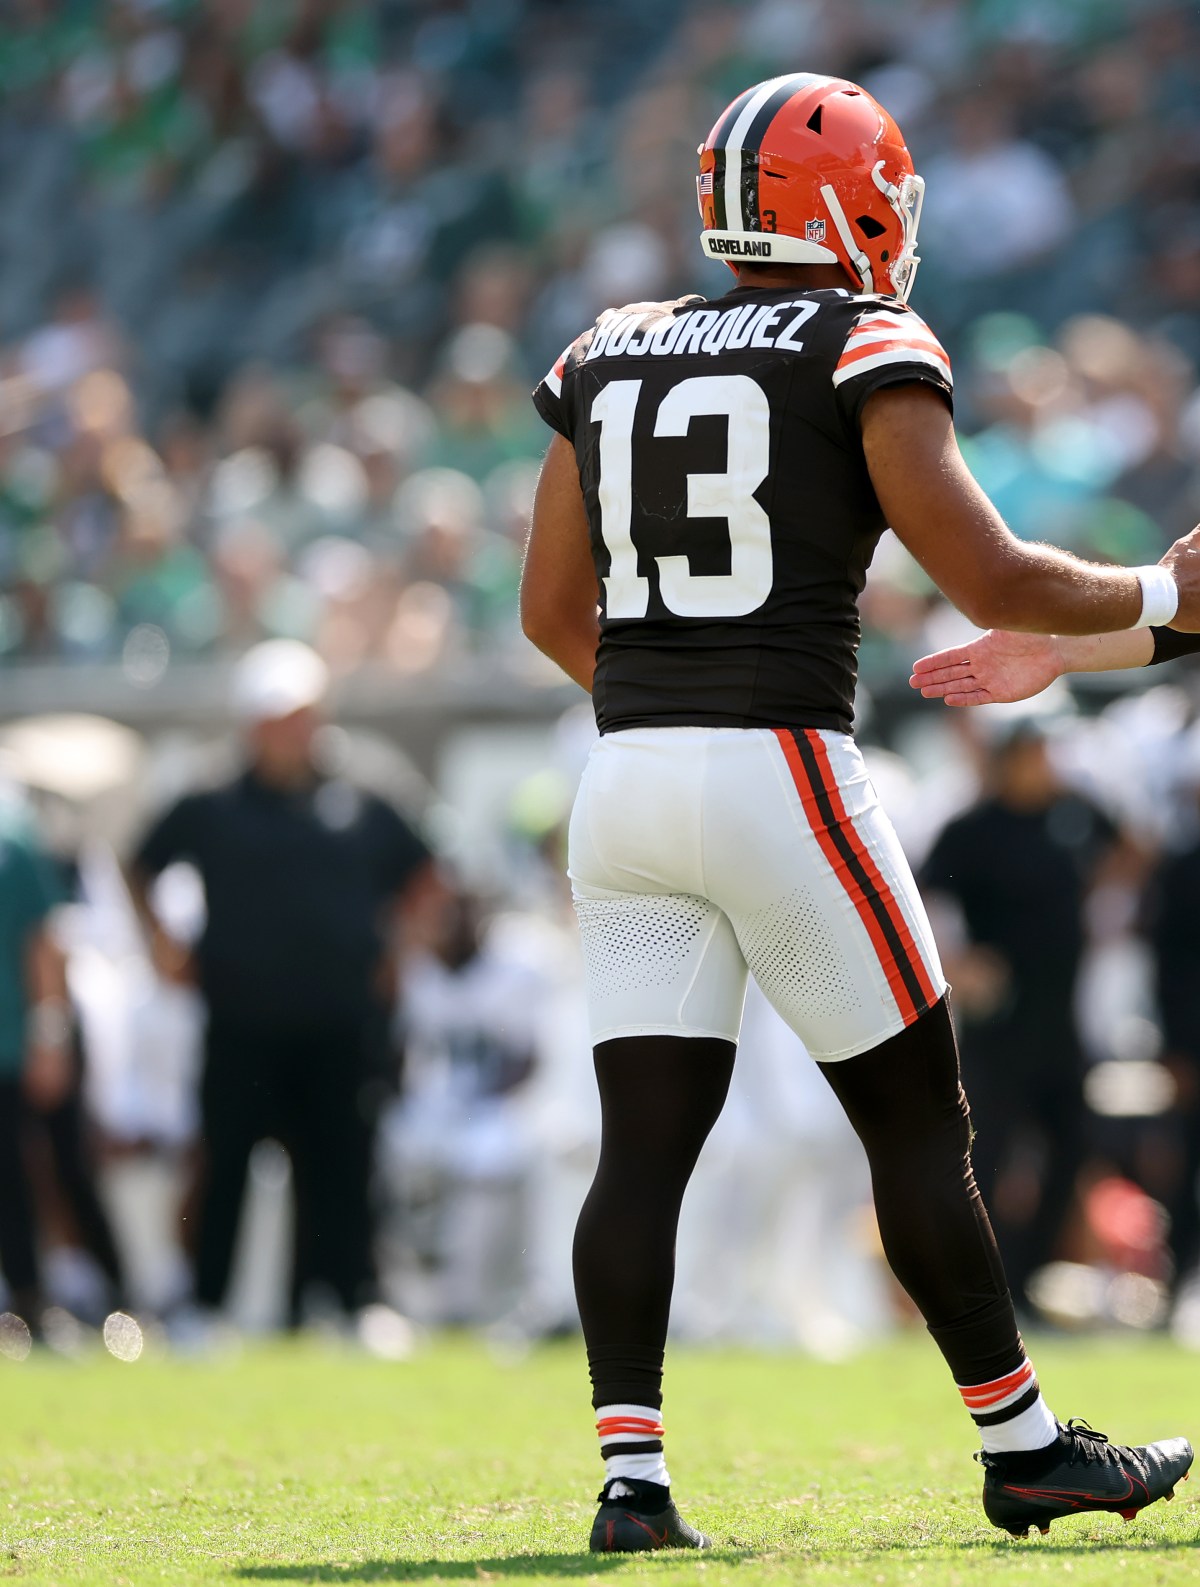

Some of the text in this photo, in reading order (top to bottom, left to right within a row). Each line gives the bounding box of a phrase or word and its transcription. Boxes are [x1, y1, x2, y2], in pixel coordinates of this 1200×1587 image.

[708, 238, 771, 256] CLEVELAND
[808, 229, 823, 240] NFL
[584, 300, 821, 362] BOJORQUEZ
[590, 374, 774, 620] 13
